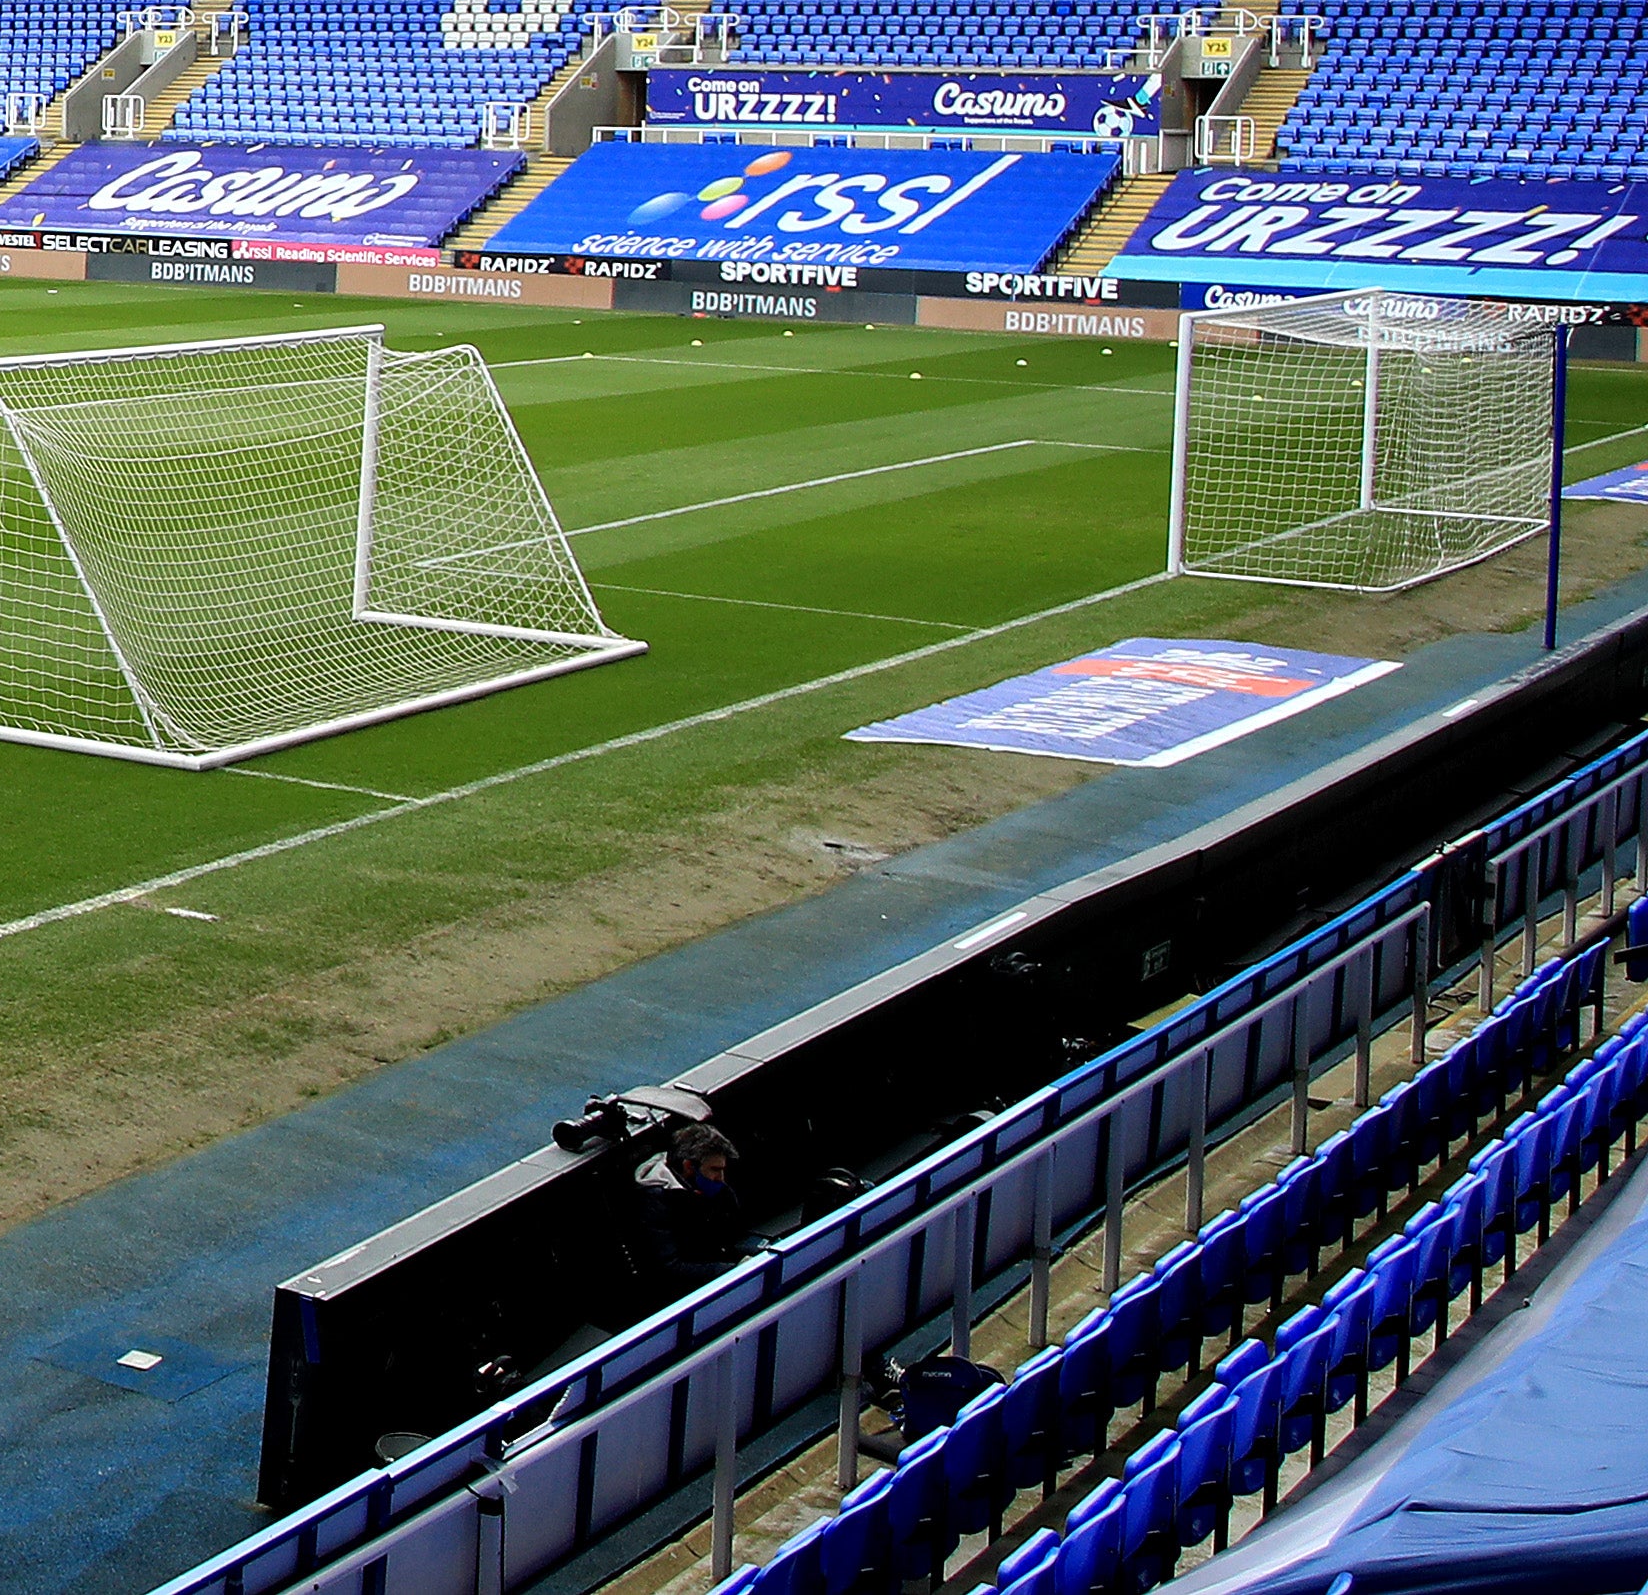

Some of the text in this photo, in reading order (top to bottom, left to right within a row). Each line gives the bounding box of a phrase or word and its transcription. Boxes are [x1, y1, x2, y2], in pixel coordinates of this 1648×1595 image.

[157, 34, 173, 44] Y23
[635, 37, 654, 47] Y24
[1206, 42, 1228, 53] Y25
[688, 77, 760, 93] Come on
[694, 92, 838, 123] URZZZZ!
[933, 82, 1066, 117] Casumo
[87, 150, 420, 220] Casumo
[724, 154, 1023, 235] rssl
[1200, 177, 1423, 204] Come on
[572, 231, 900, 265] science with service
[1151, 204, 1639, 266] URZZZZ!
[276, 246, 325, 264] Reading
[326, 249, 383, 265] Scientific
[384, 251, 436, 267] Services
[720, 260, 857, 287] SPORTFIVE
[965, 271, 1119, 300] SPORTFIVE
